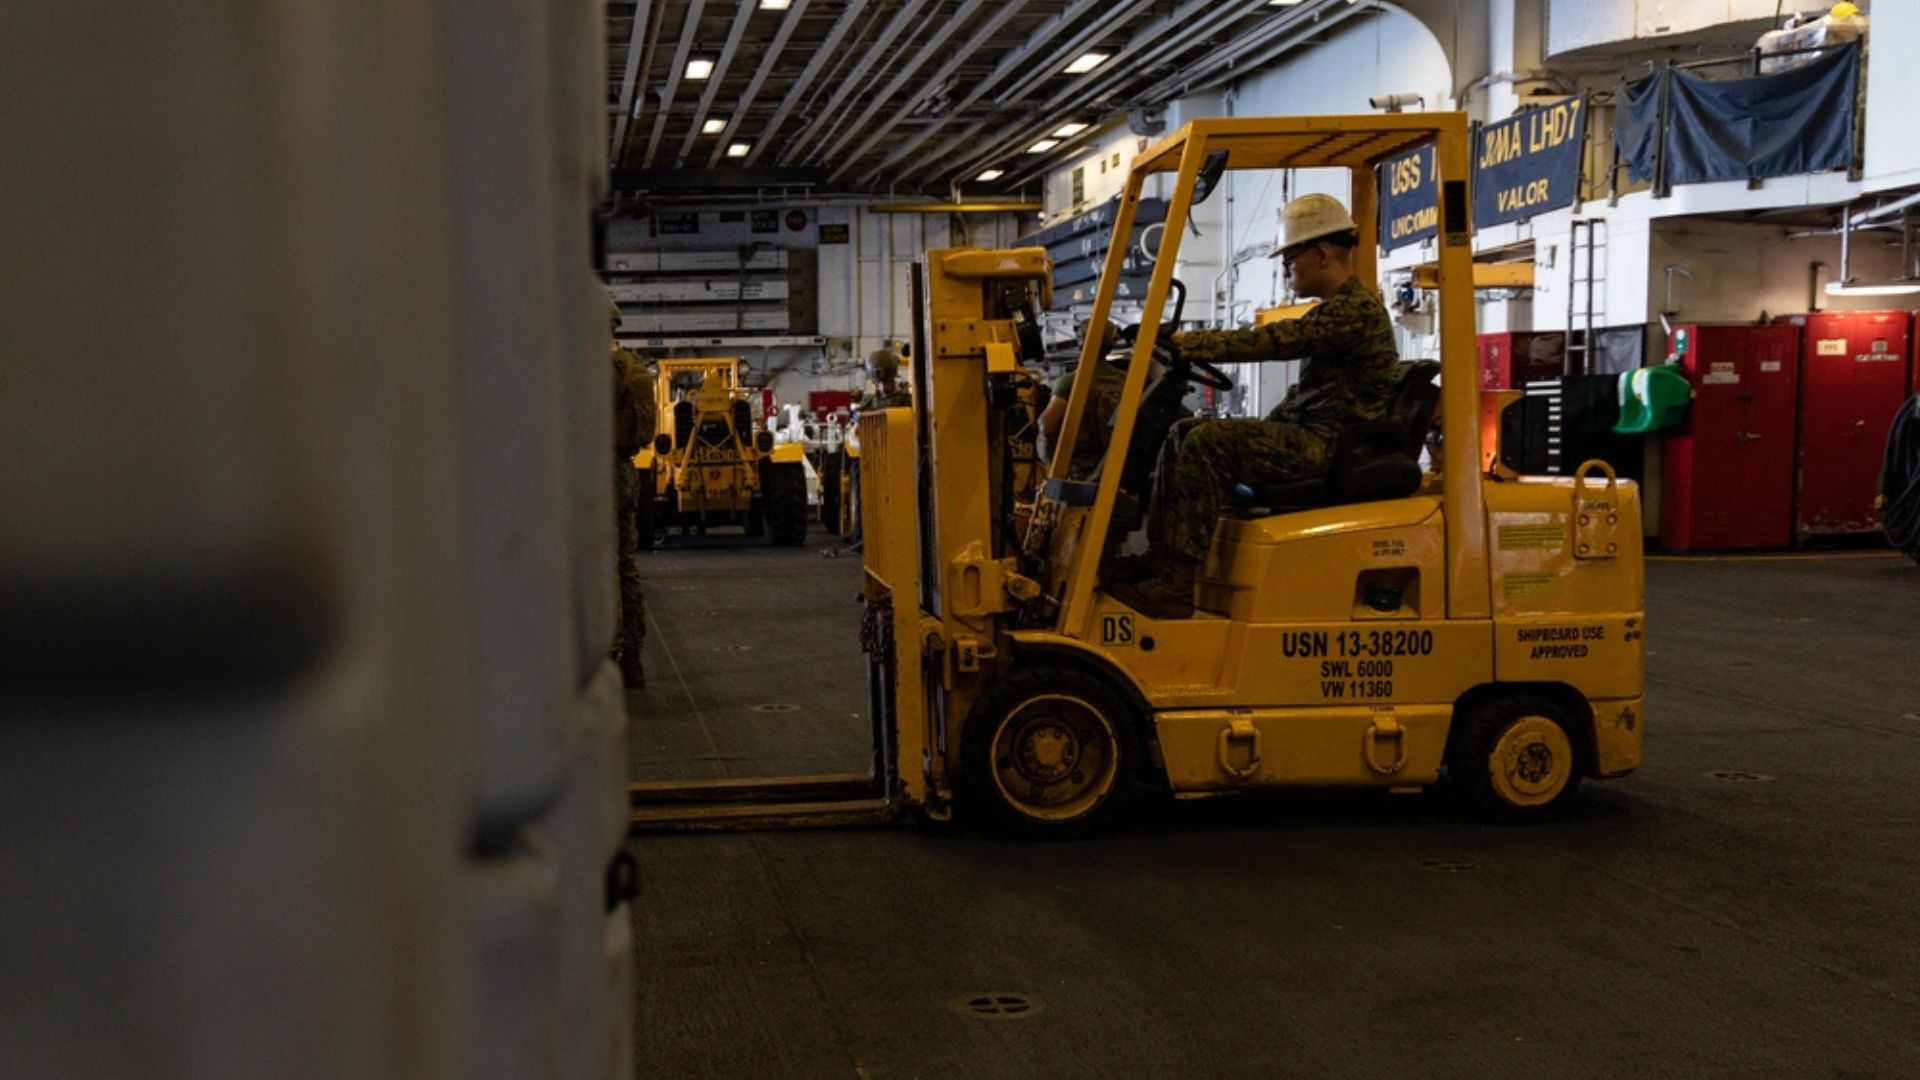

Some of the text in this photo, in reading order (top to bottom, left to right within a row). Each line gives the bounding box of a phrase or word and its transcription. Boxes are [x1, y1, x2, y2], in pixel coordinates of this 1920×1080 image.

[1391, 153, 1421, 196] USS
[1480, 120, 1521, 169] JIMA
[1391, 178, 1549, 239] UNCOMM VALOR
[1103, 615, 1132, 642] DS
[1517, 625, 1604, 642] SHIPBOARD USE
[1282, 630, 1433, 657] USN 13-38200
[1530, 644, 1588, 659] APPROVED
[1320, 660, 1393, 678] SWL 6000
[1321, 681, 1393, 697] VW 11360
